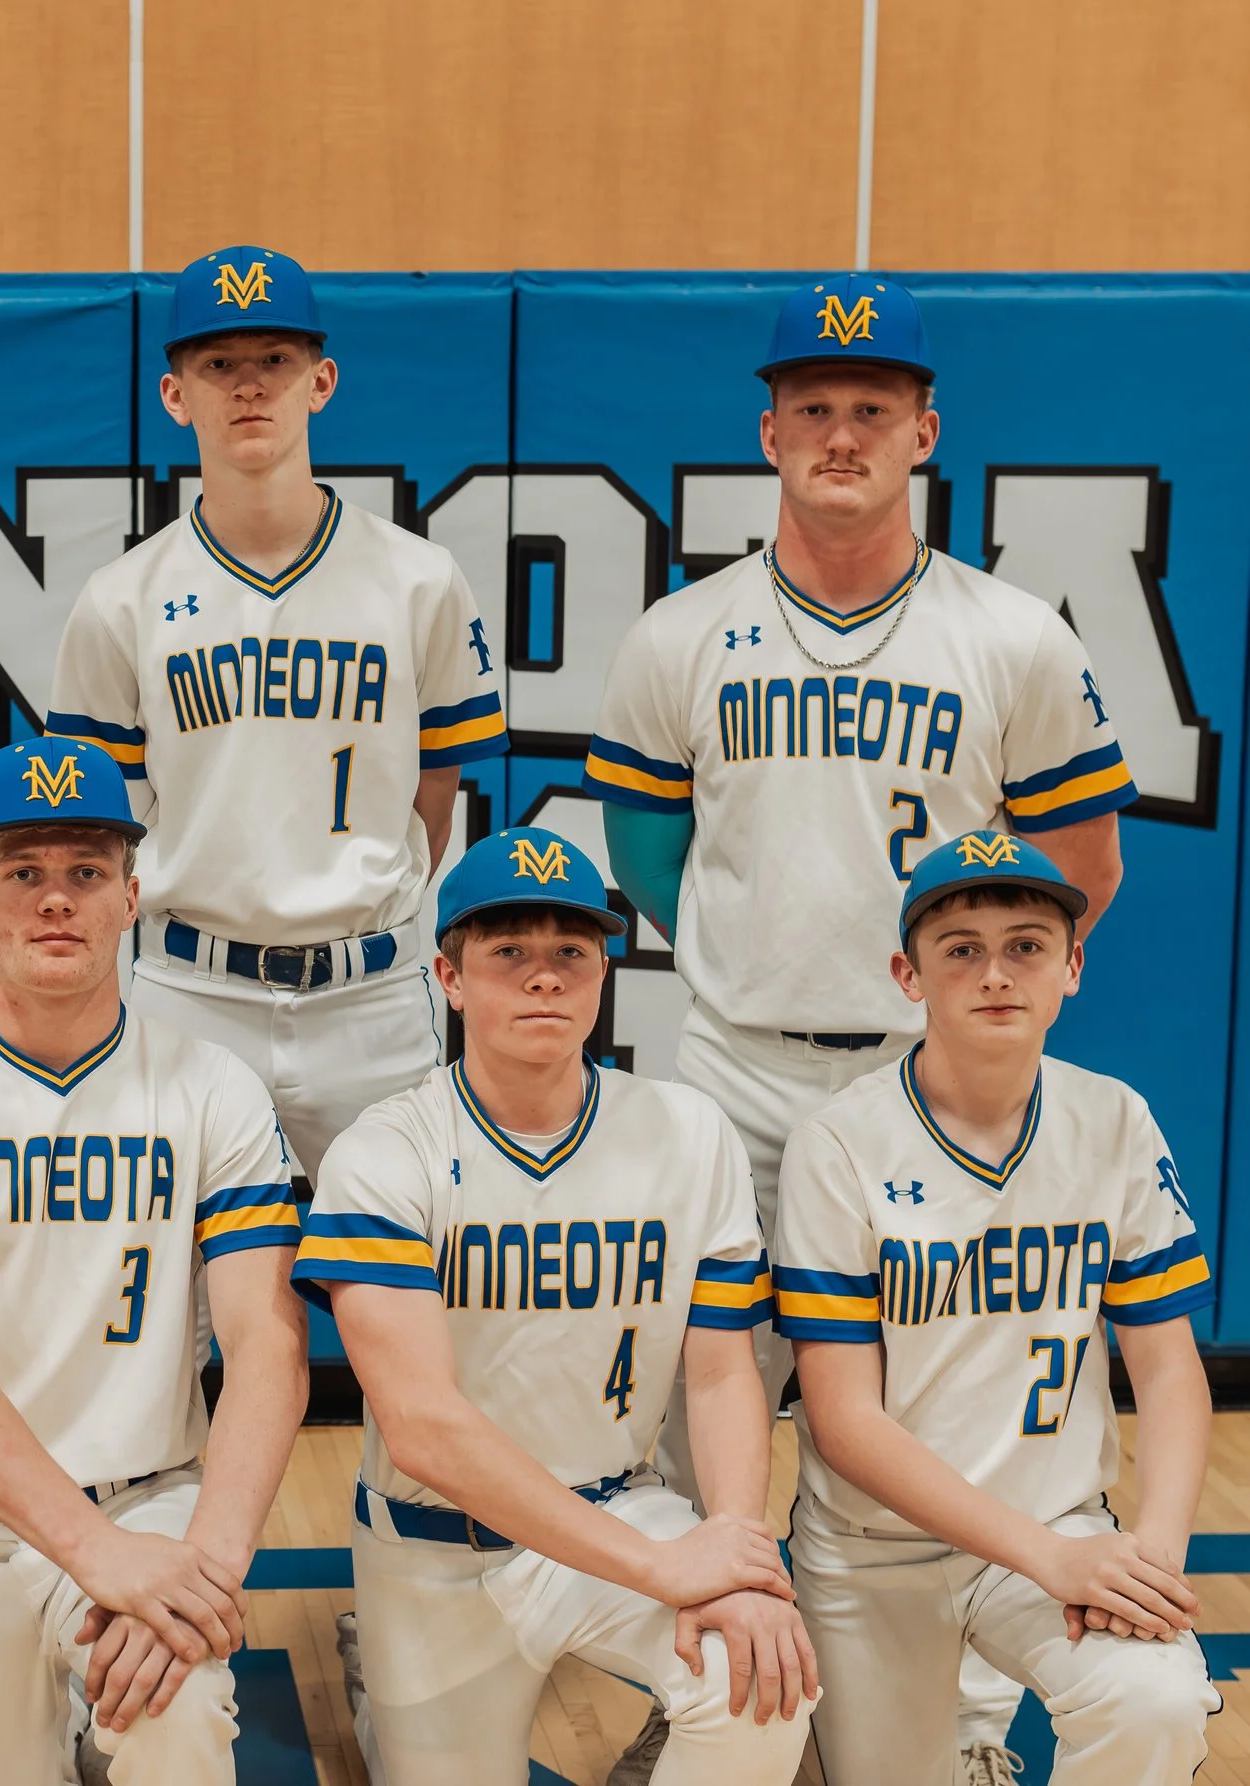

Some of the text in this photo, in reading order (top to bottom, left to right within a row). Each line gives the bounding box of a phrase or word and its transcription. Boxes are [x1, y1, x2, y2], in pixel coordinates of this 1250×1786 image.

[166, 636, 388, 735] MINNEOTA
[718, 676, 963, 776] MINNEOTA
[330, 743, 356, 835] 1
[886, 787, 931, 885] 2
[102, 1244, 152, 1347] 3
[435, 1218, 667, 1312] INNEOTA
[879, 1221, 1111, 1327] MINNEOTA
[602, 1325, 638, 1423] 4
